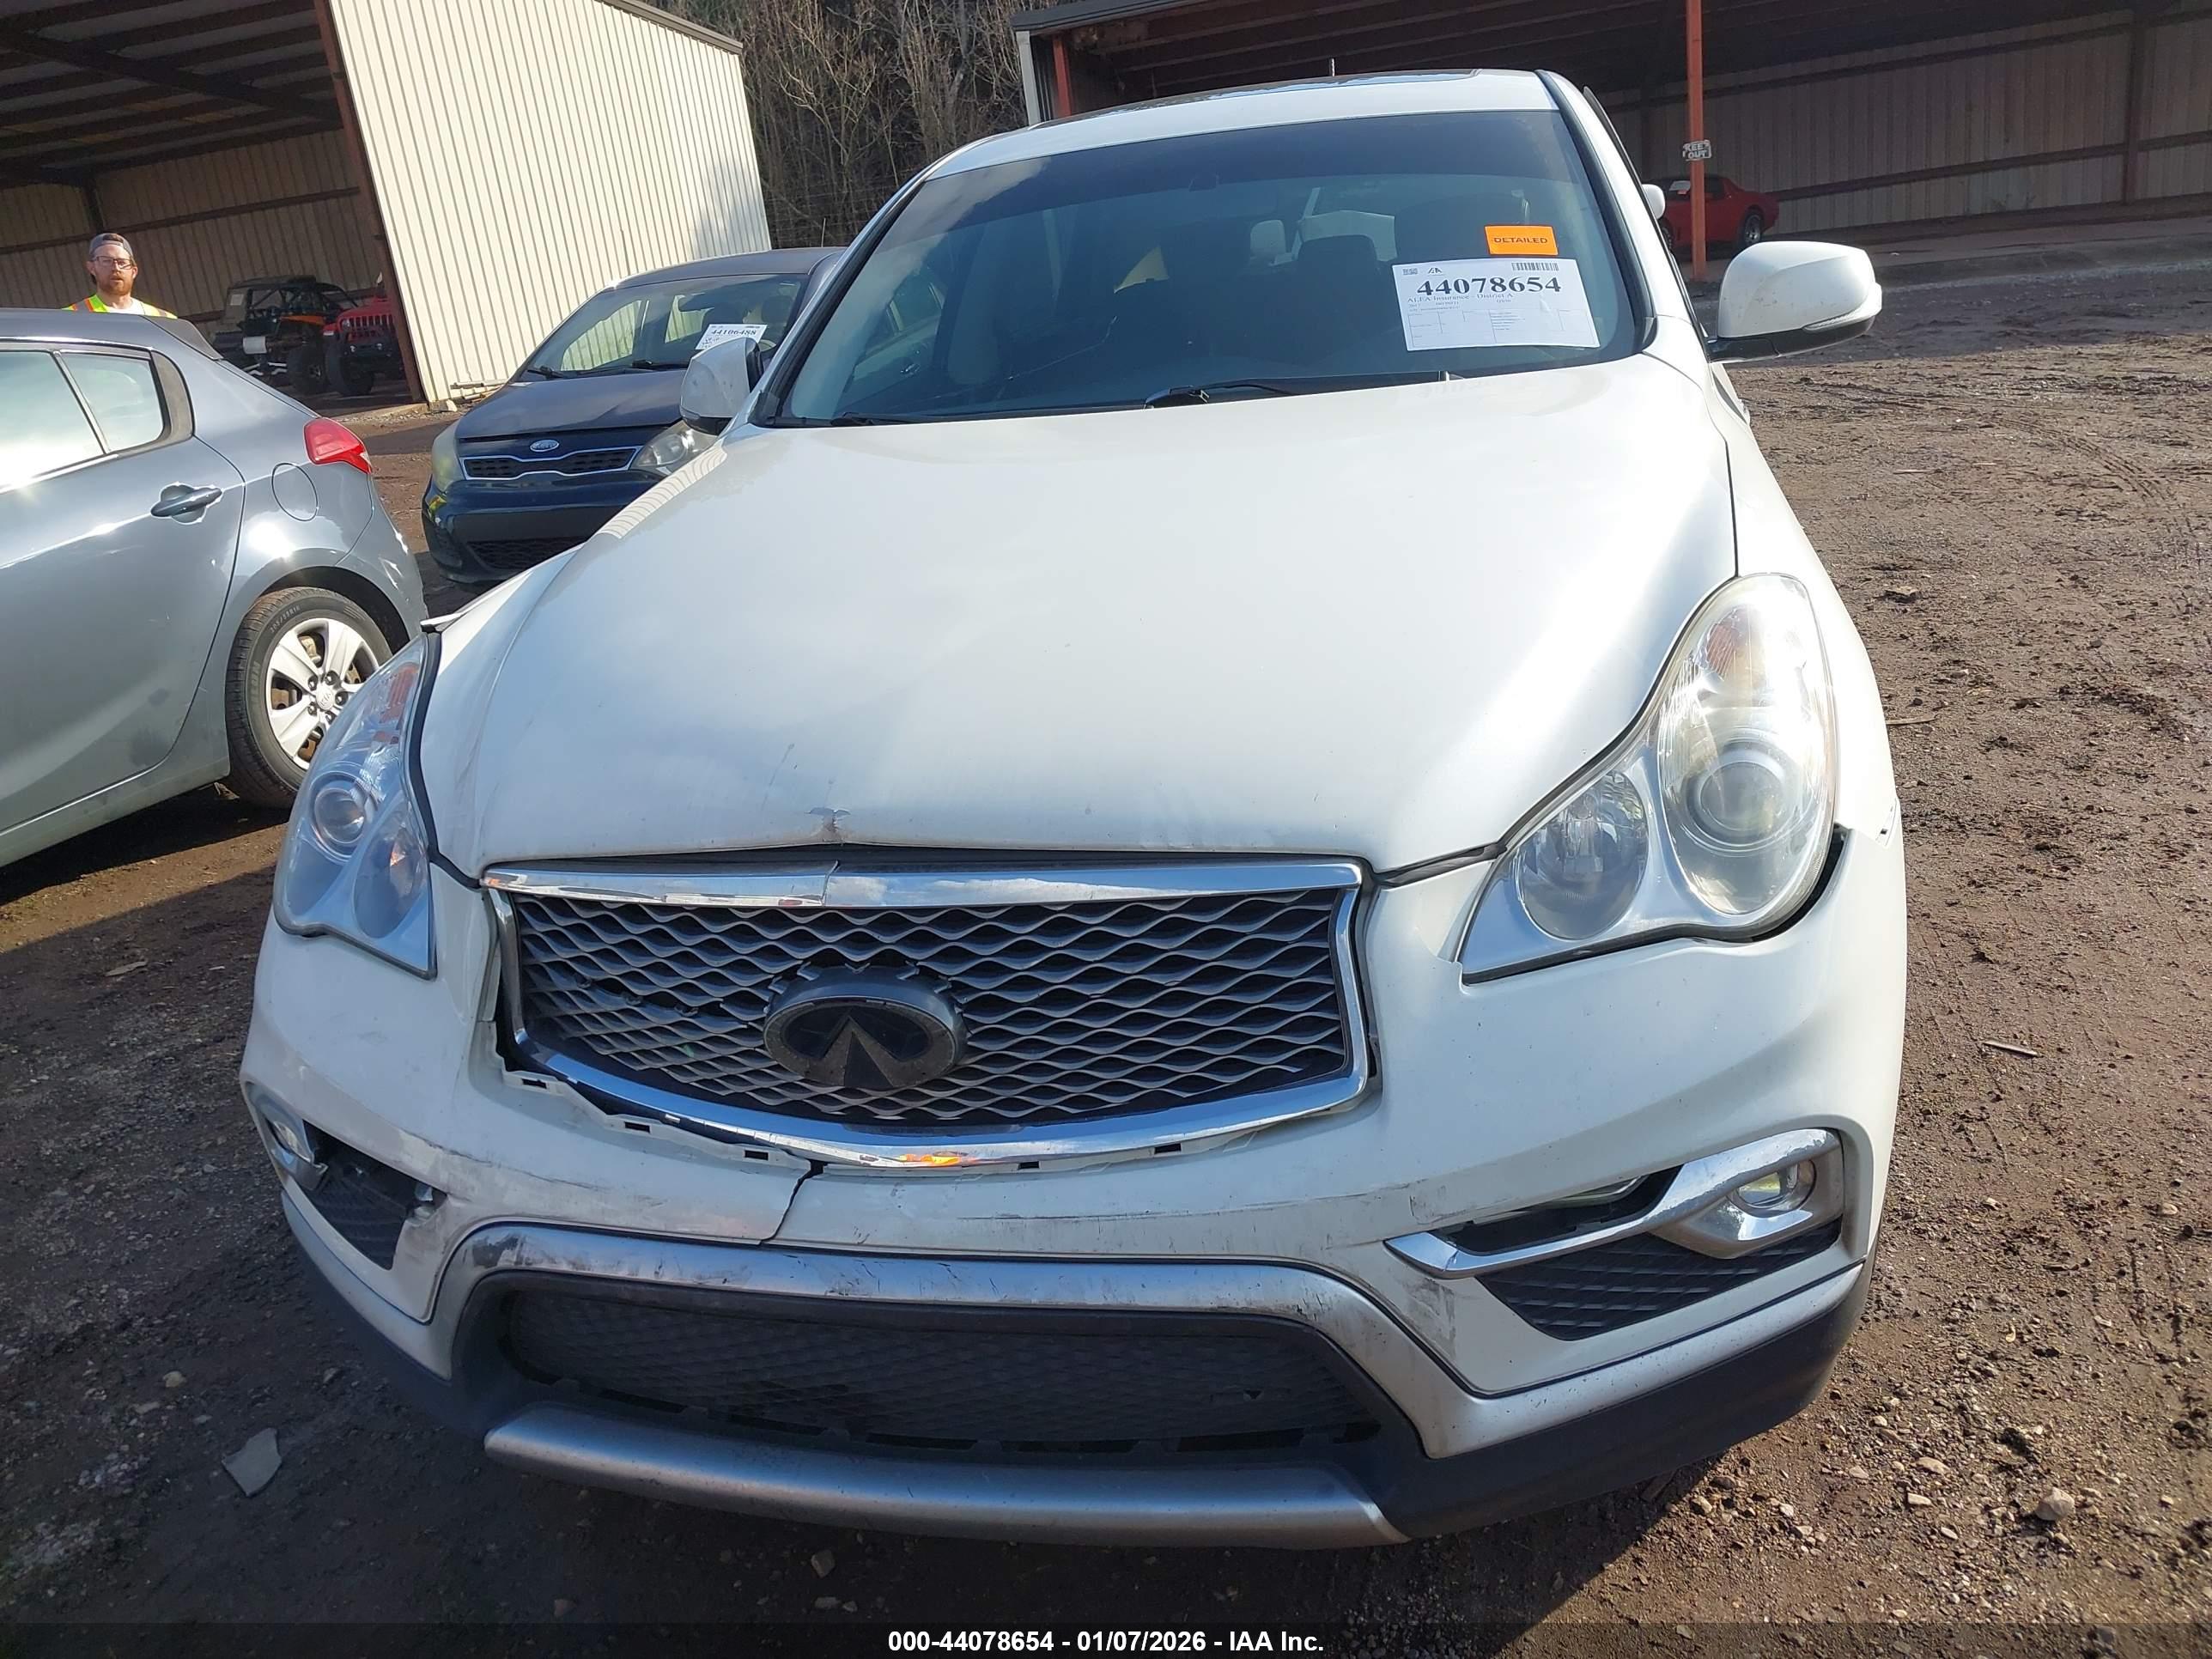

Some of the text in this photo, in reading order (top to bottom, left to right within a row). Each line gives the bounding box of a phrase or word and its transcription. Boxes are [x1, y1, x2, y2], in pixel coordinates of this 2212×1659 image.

[1688, 149, 1707, 159] OUT
[1417, 276, 1561, 296] 44078654
[1433, 293, 1469, 301] Insurance
